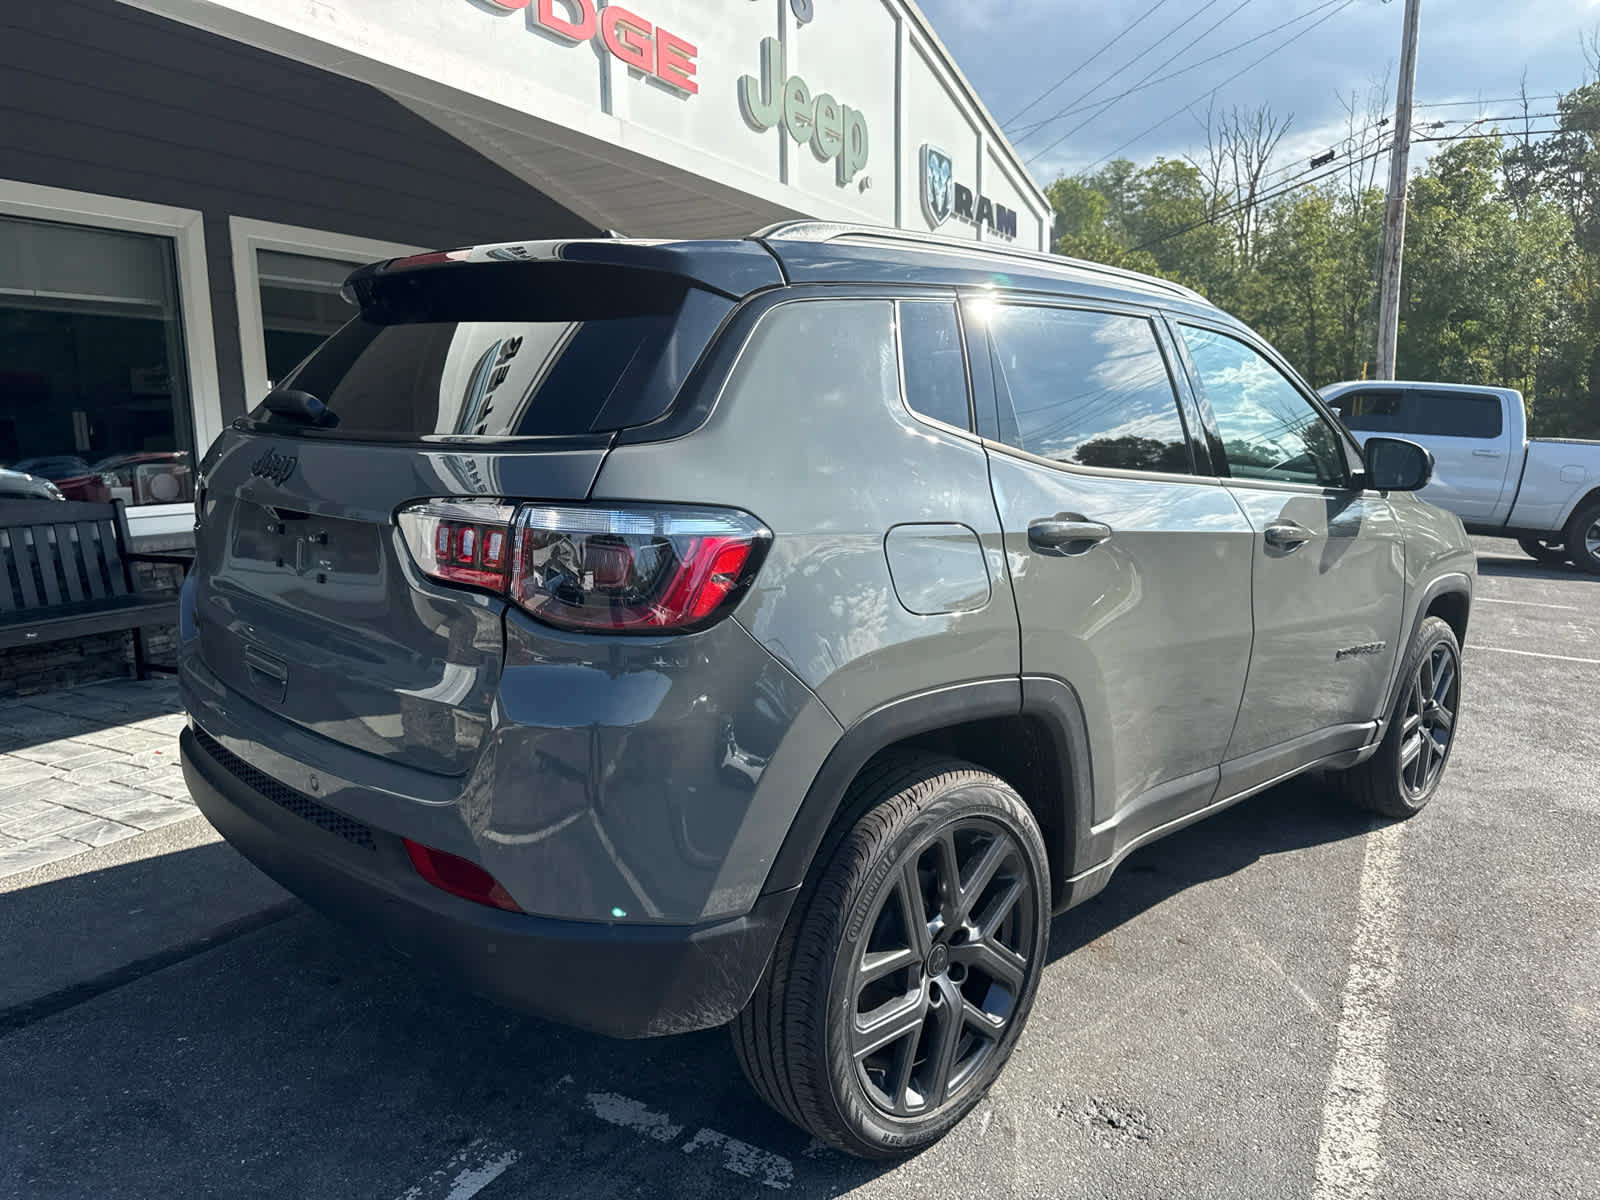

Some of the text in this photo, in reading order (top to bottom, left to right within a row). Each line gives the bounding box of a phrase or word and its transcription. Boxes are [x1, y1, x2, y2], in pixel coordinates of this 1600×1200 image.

[480, 0, 699, 95] DGE
[738, 36, 869, 187] Jeep
[952, 181, 1017, 238] RAM
[252, 447, 297, 488] Jeep
